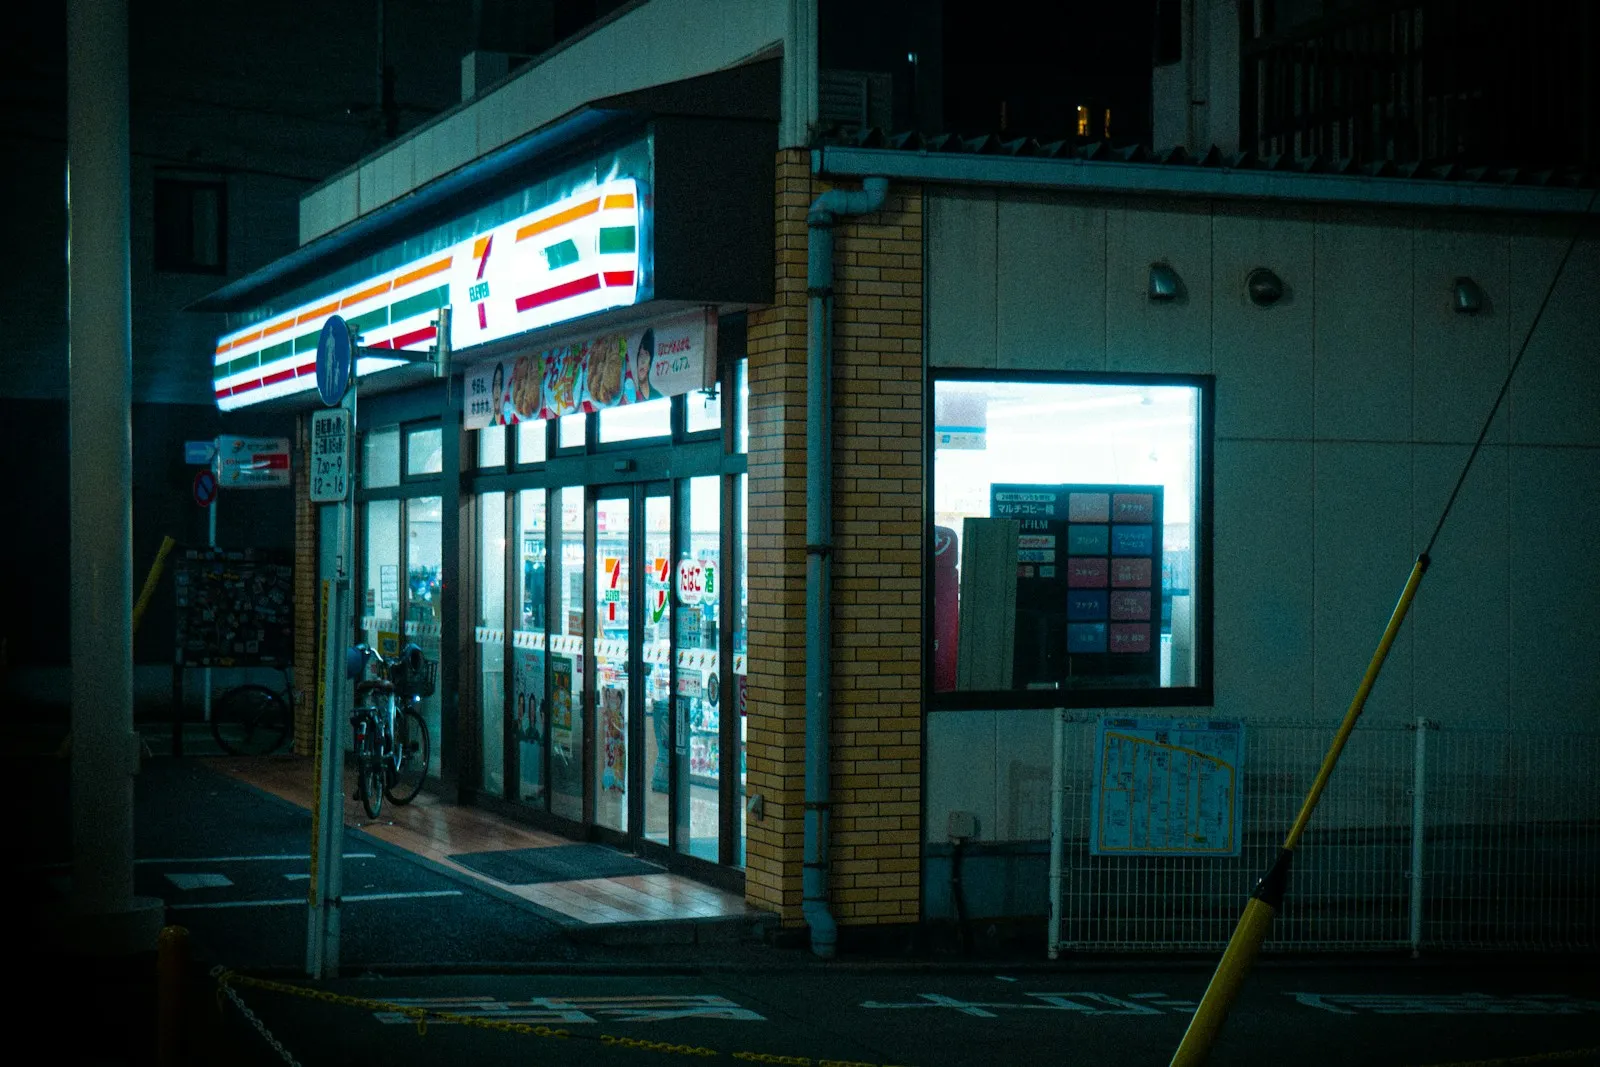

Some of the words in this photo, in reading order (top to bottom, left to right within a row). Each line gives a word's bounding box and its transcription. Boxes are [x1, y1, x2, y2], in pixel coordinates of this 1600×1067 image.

[998, 504, 1055, 515] マルチコピー機
[1021, 519, 1048, 530] FILM
[681, 566, 701, 592] たばこ
[704, 567, 714, 593] 酒
